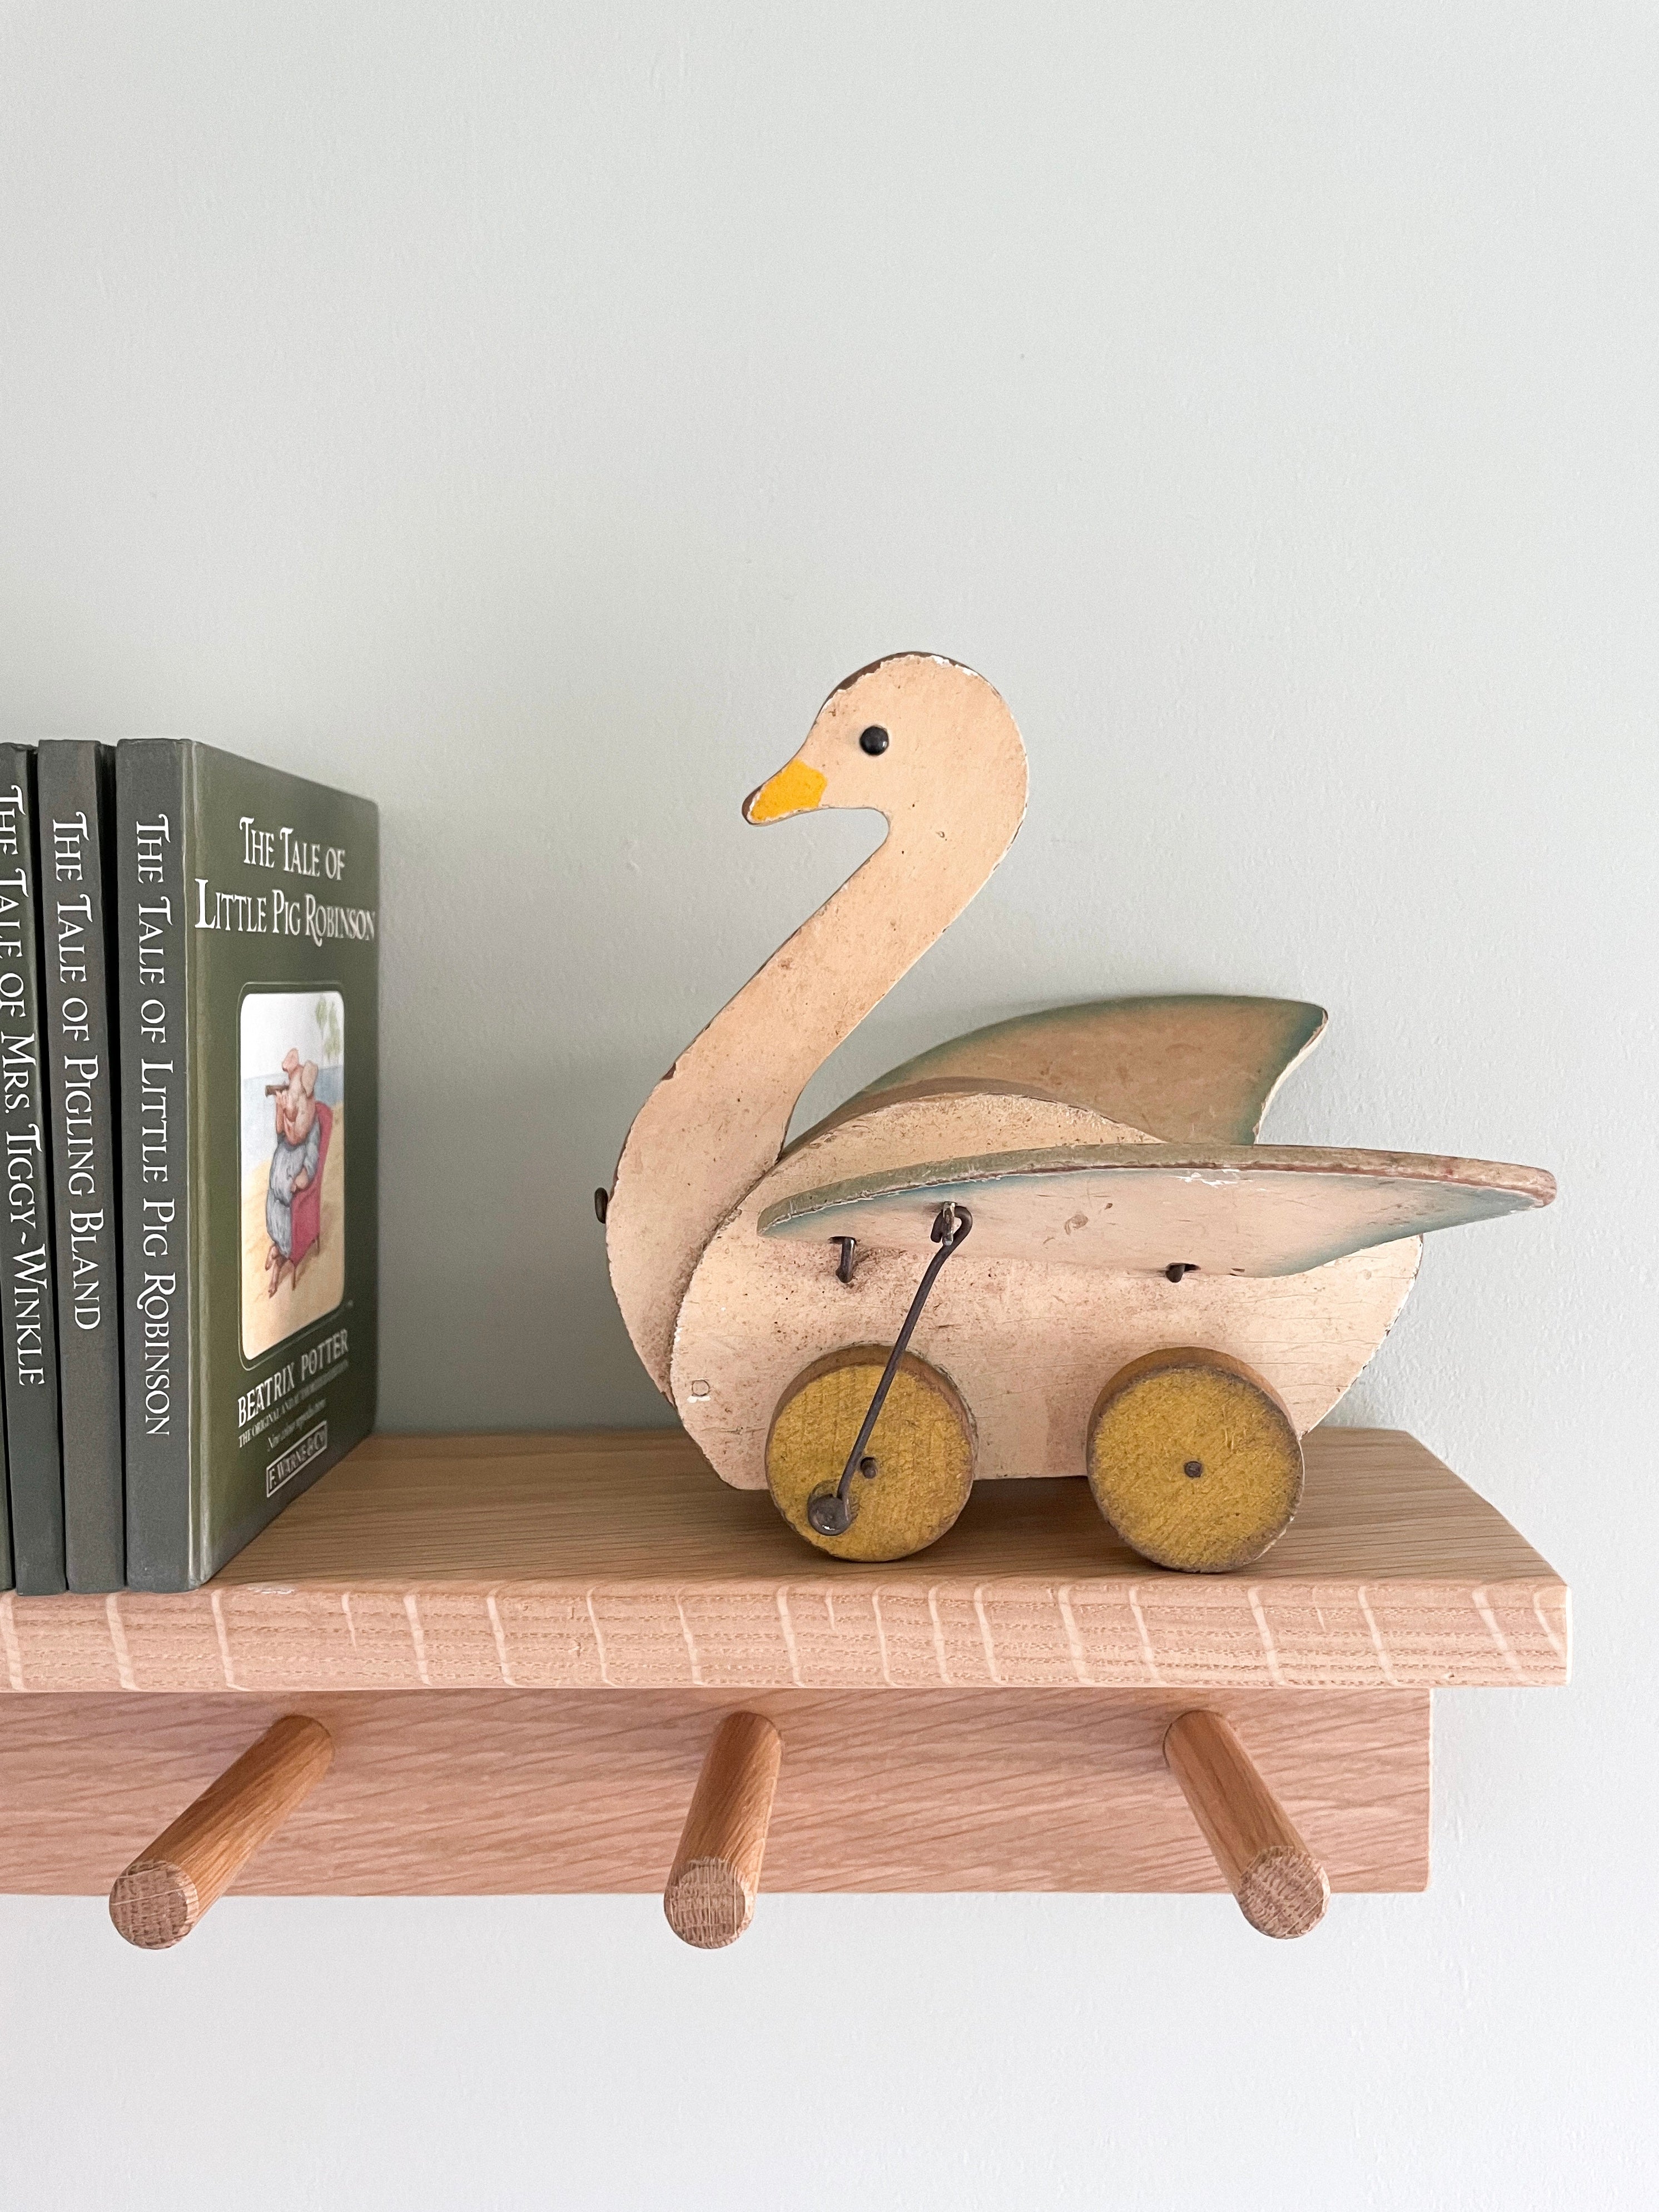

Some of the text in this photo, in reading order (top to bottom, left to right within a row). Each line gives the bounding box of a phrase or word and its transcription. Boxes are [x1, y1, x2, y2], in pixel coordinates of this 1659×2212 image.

[0, 785, 26, 855] THE
[239, 816, 346, 881] THE TALE OF
[0, 867, 29, 959] TALE
[195, 878, 376, 947] LITTLE PIG ROBINSON
[0, 973, 26, 1018] OF
[1, 1031, 37, 1114] MRS.
[53, 811, 104, 1330] THE TALE OF PIGLING BLAND
[136, 814, 176, 1436] THE TALE OF LITTLE PIG ROBINSON
[237, 1362, 295, 1428] BEATRIX
[301, 1328, 348, 1381] POTTER
